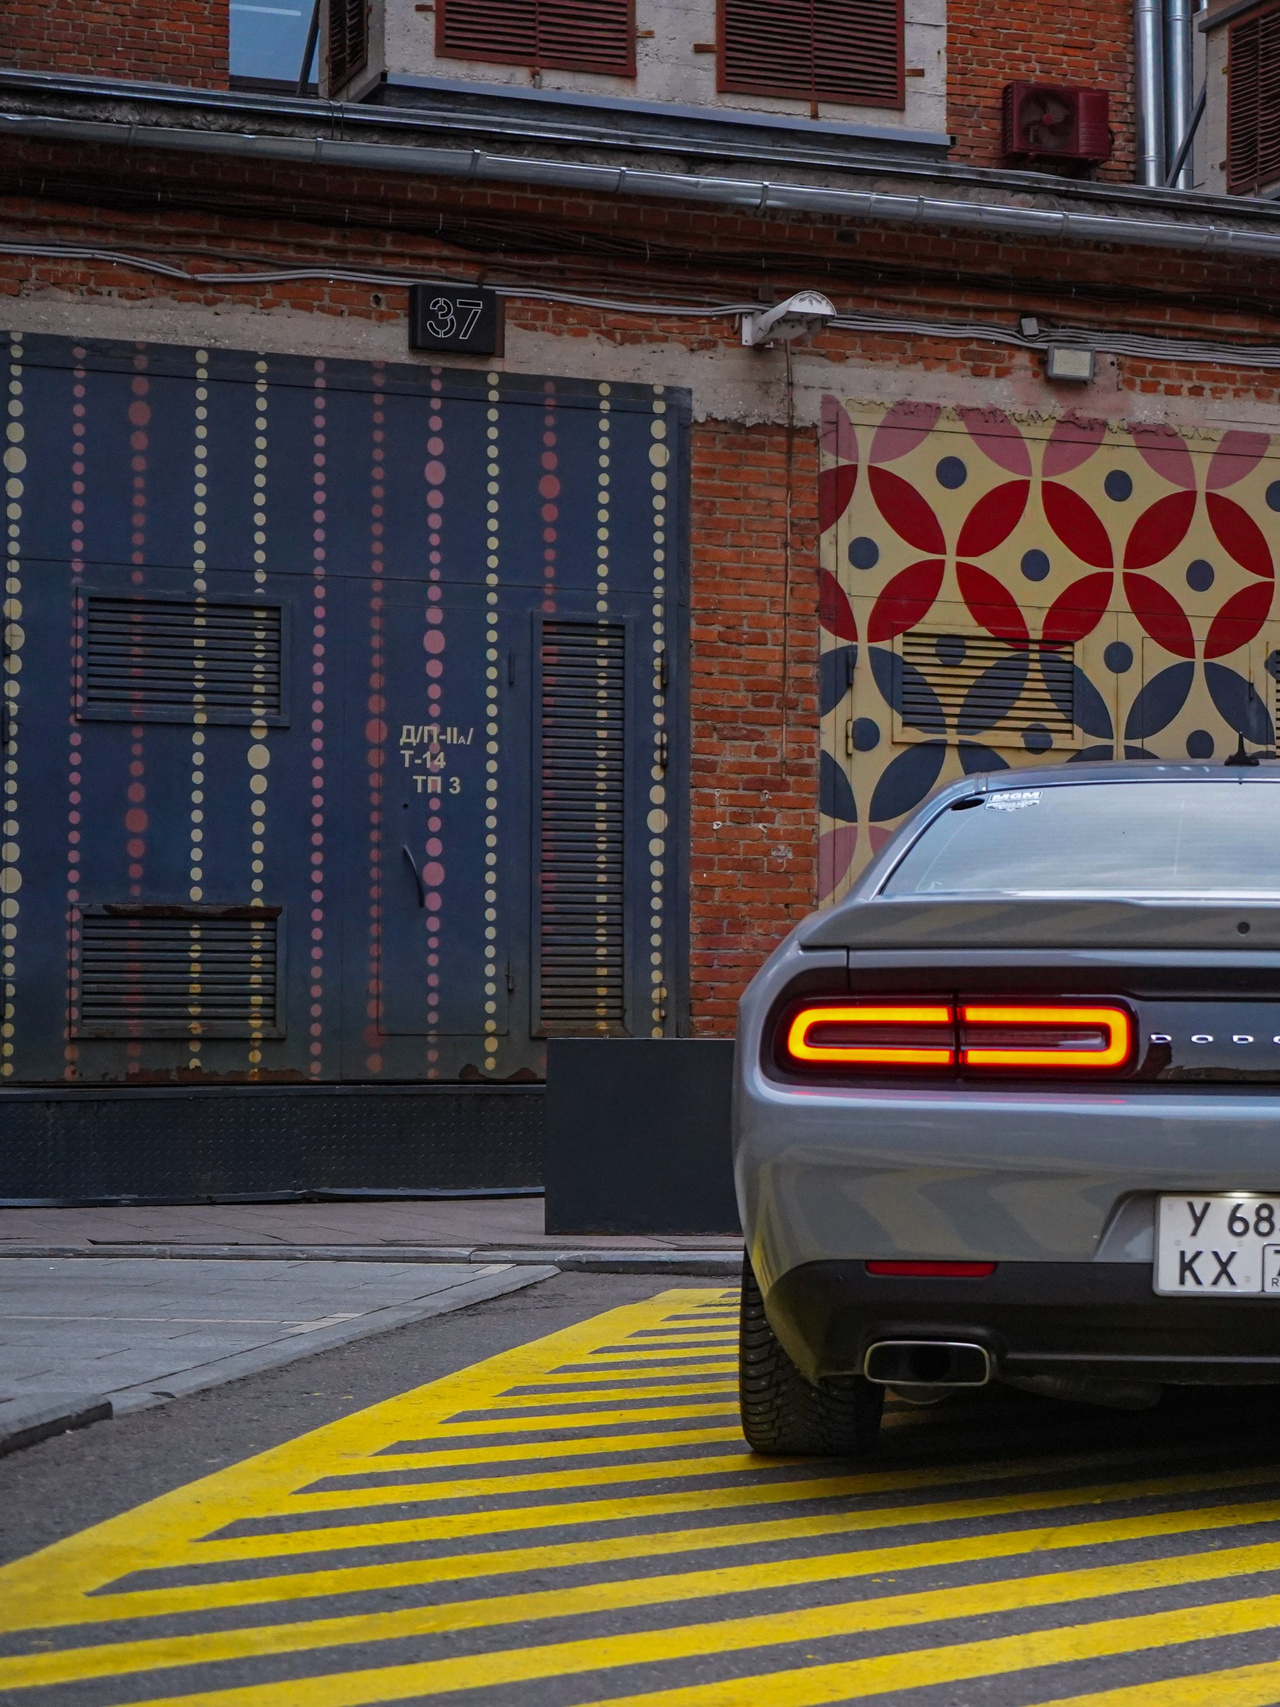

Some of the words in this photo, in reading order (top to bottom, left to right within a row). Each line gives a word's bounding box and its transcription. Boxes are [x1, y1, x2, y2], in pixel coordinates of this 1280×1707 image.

[426, 297, 483, 340] 37
[400, 749, 447, 769] Т-14
[412, 775, 442, 794] ТП
[448, 776, 461, 795] 3
